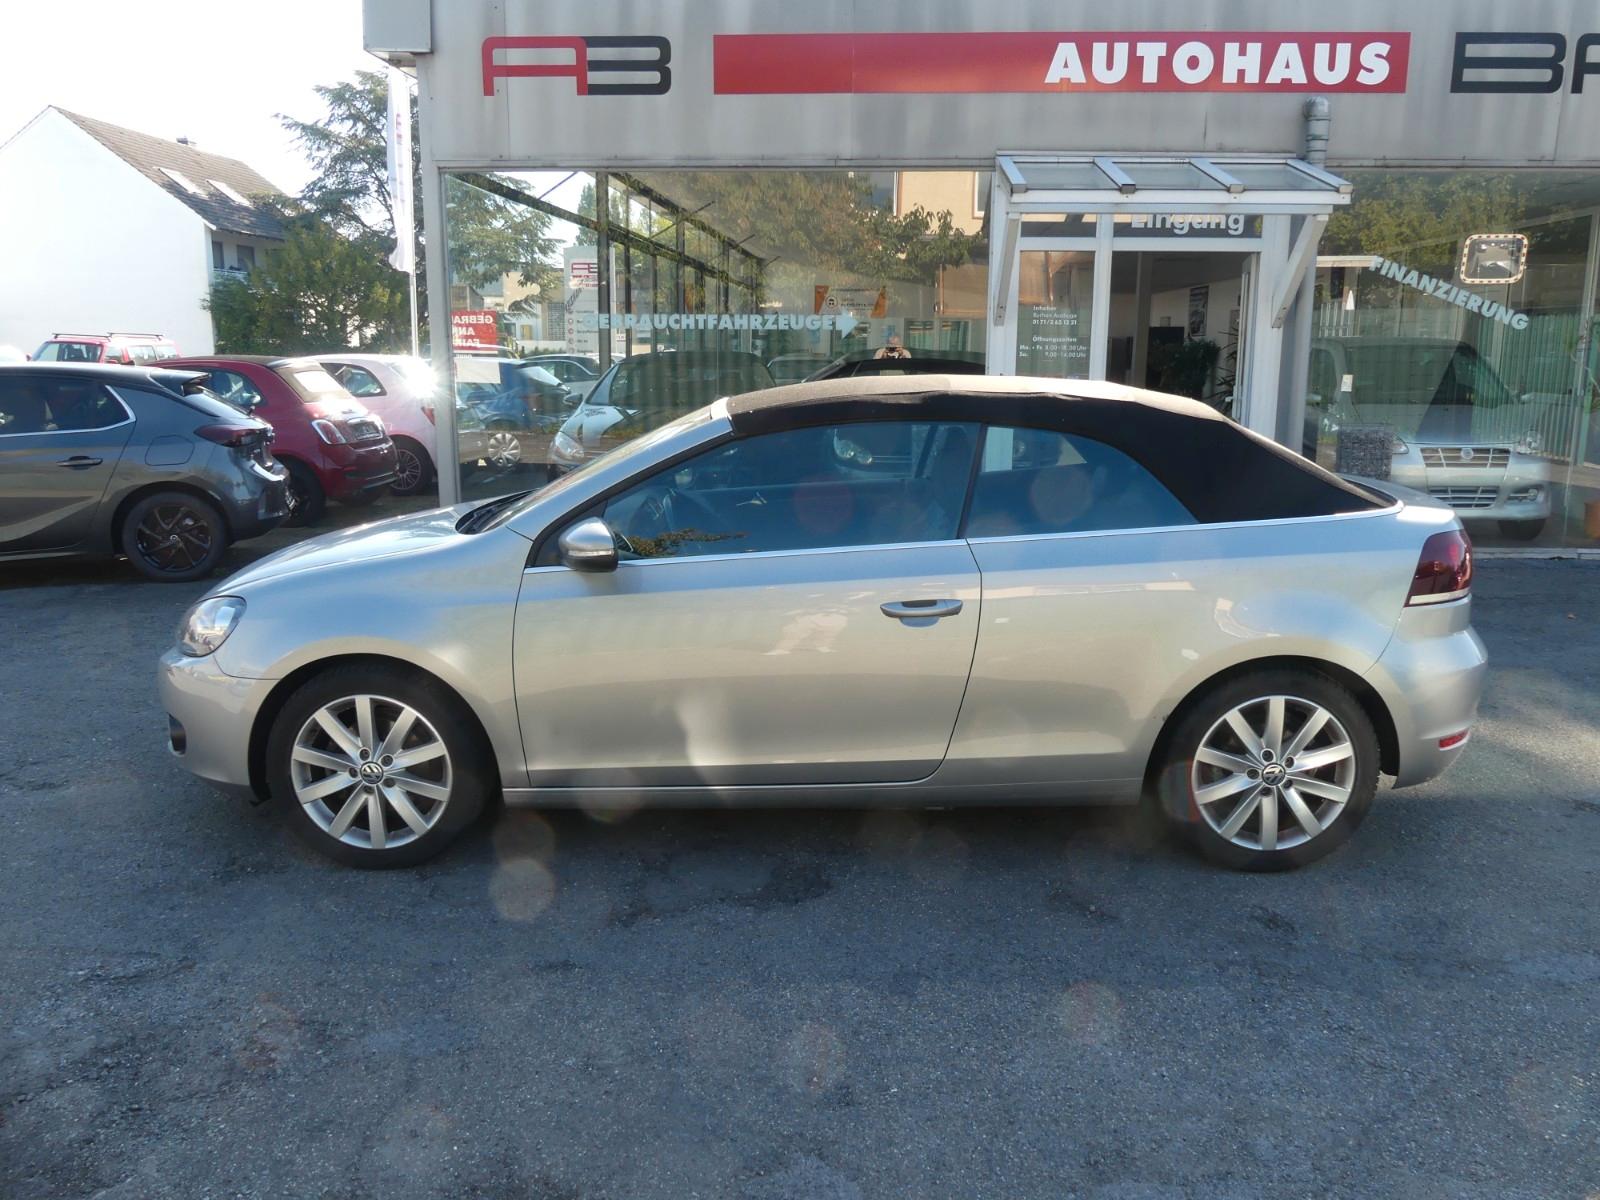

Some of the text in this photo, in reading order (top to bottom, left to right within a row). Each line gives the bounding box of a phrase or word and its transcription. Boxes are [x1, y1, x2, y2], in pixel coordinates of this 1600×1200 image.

[482, 32, 1600, 96] AB AUTOHAUS B
[1131, 213, 1245, 235] Eingang
[1368, 256, 1529, 330] FINANZIERUNG
[583, 313, 836, 330] GEBRAUCHTFAHRZEUGE
